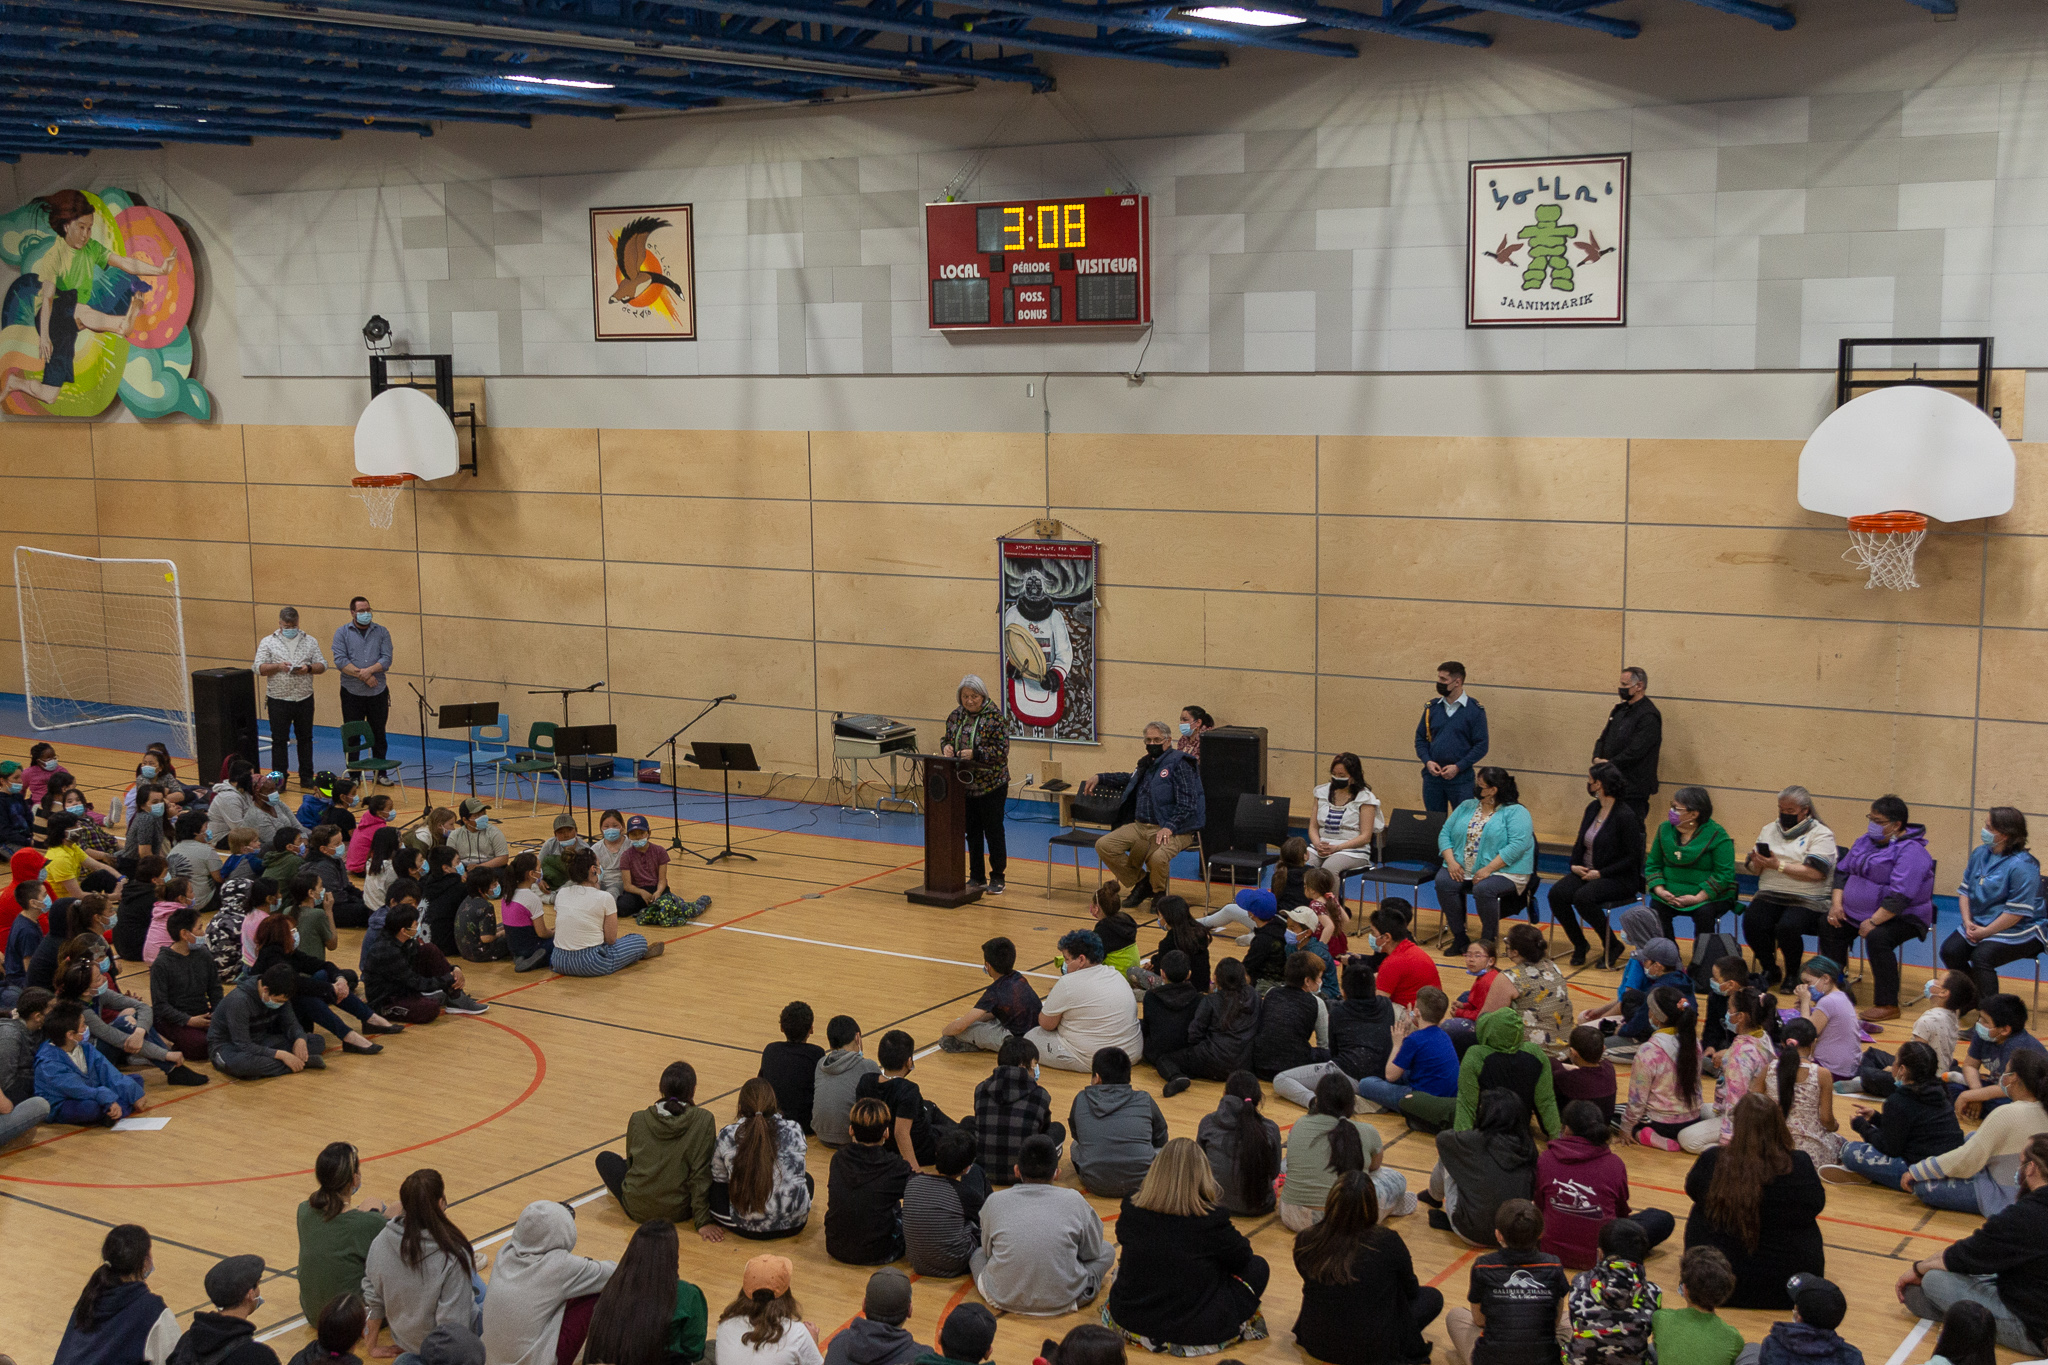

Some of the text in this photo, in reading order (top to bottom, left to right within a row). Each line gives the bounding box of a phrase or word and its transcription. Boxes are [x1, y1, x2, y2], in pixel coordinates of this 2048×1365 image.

[1003, 203, 1086, 251] 3:08
[940, 263, 980, 279] LOCAL
[1012, 261, 1051, 274] PÉRIODE
[1076, 257, 1137, 274] VISITEUR
[1020, 291, 1045, 302] POSS.
[1500, 292, 1595, 311] JAANIMMARIK
[1017, 309, 1048, 320] BONUS
